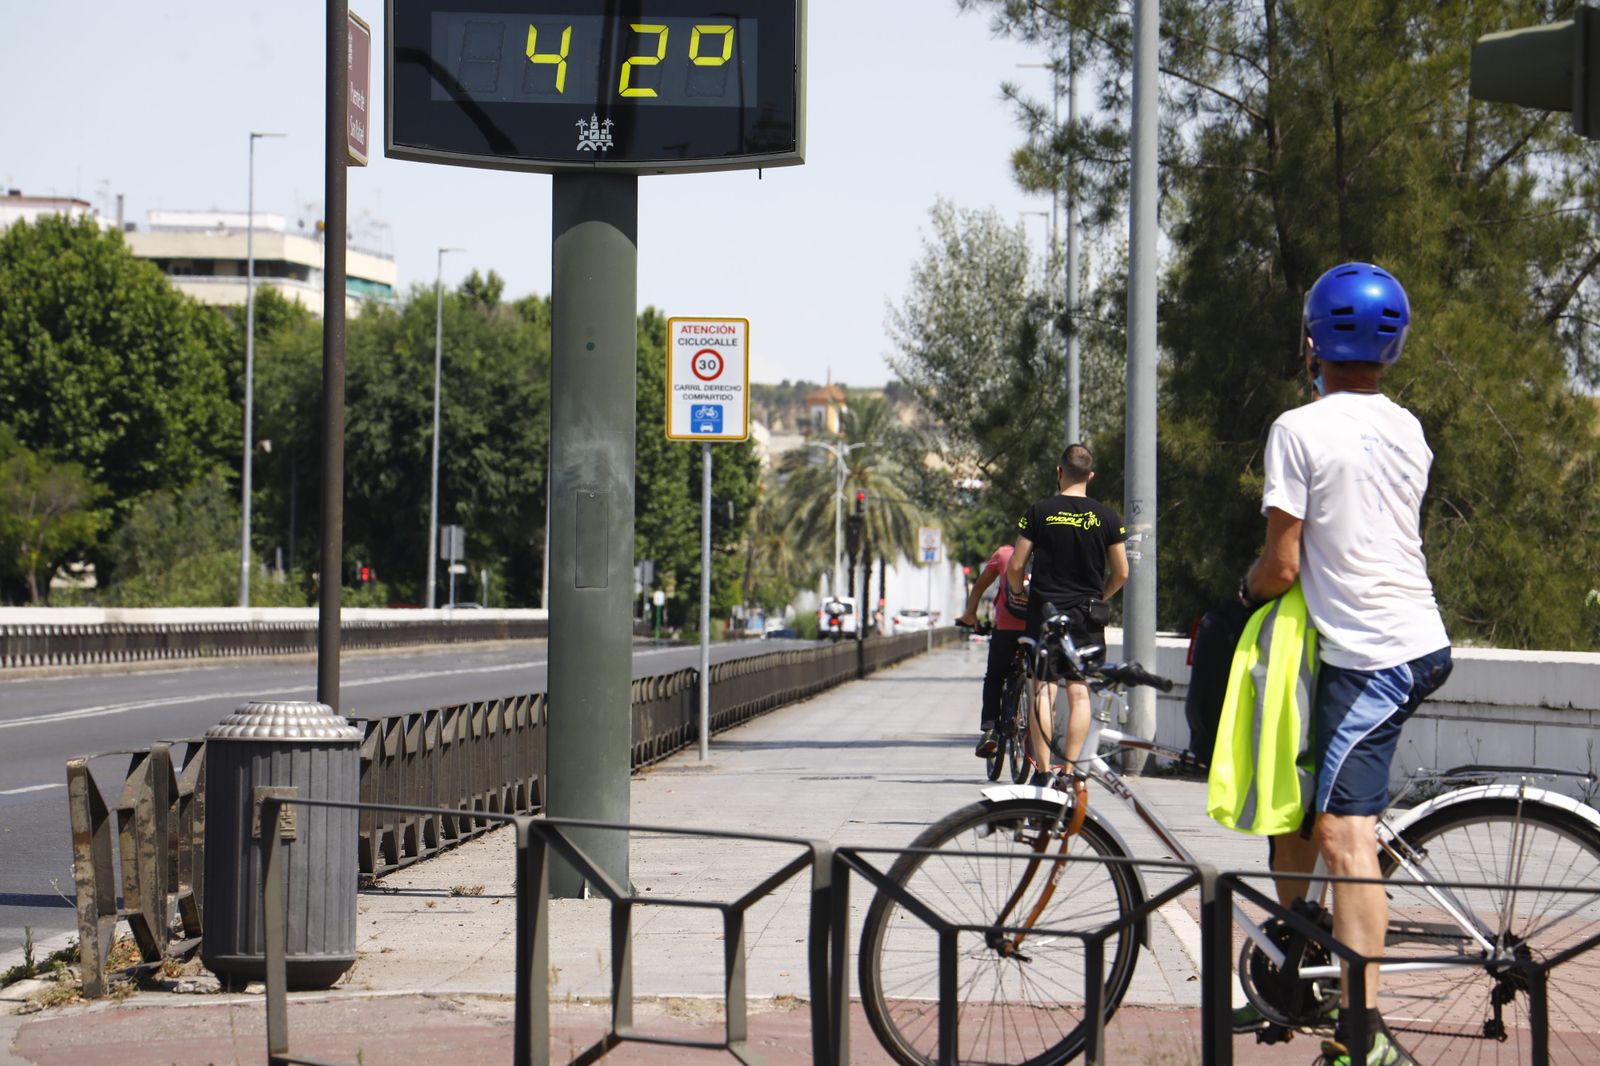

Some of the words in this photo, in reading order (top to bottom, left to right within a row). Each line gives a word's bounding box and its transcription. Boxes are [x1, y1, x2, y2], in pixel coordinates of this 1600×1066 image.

[680, 324, 736, 335] ATENCIÓN
[677, 337, 738, 347] CICLOCALLE
[698, 359, 717, 370] 30
[674, 384, 702, 392] CARRIL
[703, 384, 742, 392] DERECHO
[682, 393, 734, 401] COMPARTIDO
